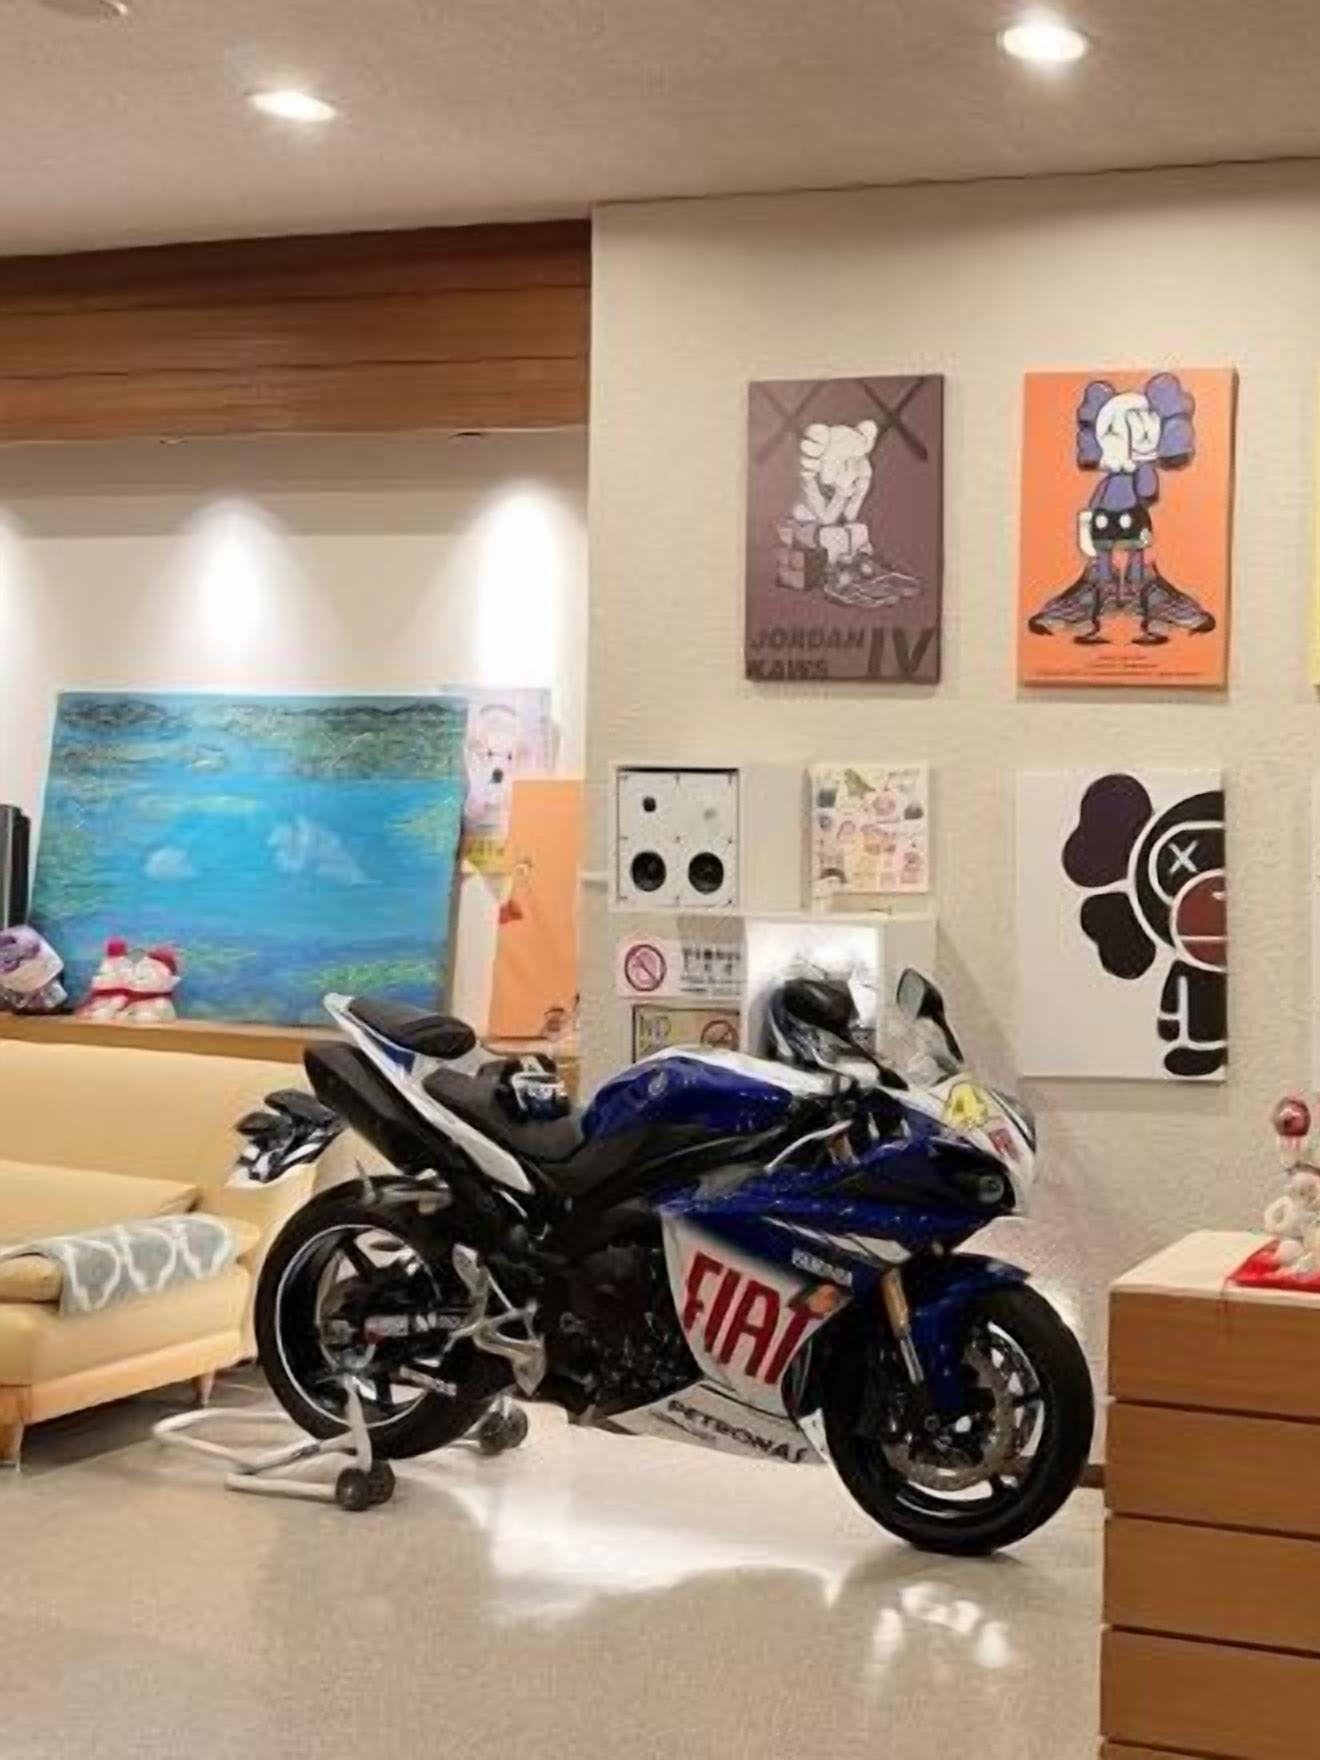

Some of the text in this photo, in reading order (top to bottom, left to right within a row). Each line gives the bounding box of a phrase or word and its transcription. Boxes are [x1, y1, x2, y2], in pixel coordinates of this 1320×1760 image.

[750, 627, 936, 682] JORDAN IV
[683, 1252, 826, 1385] FIAT
